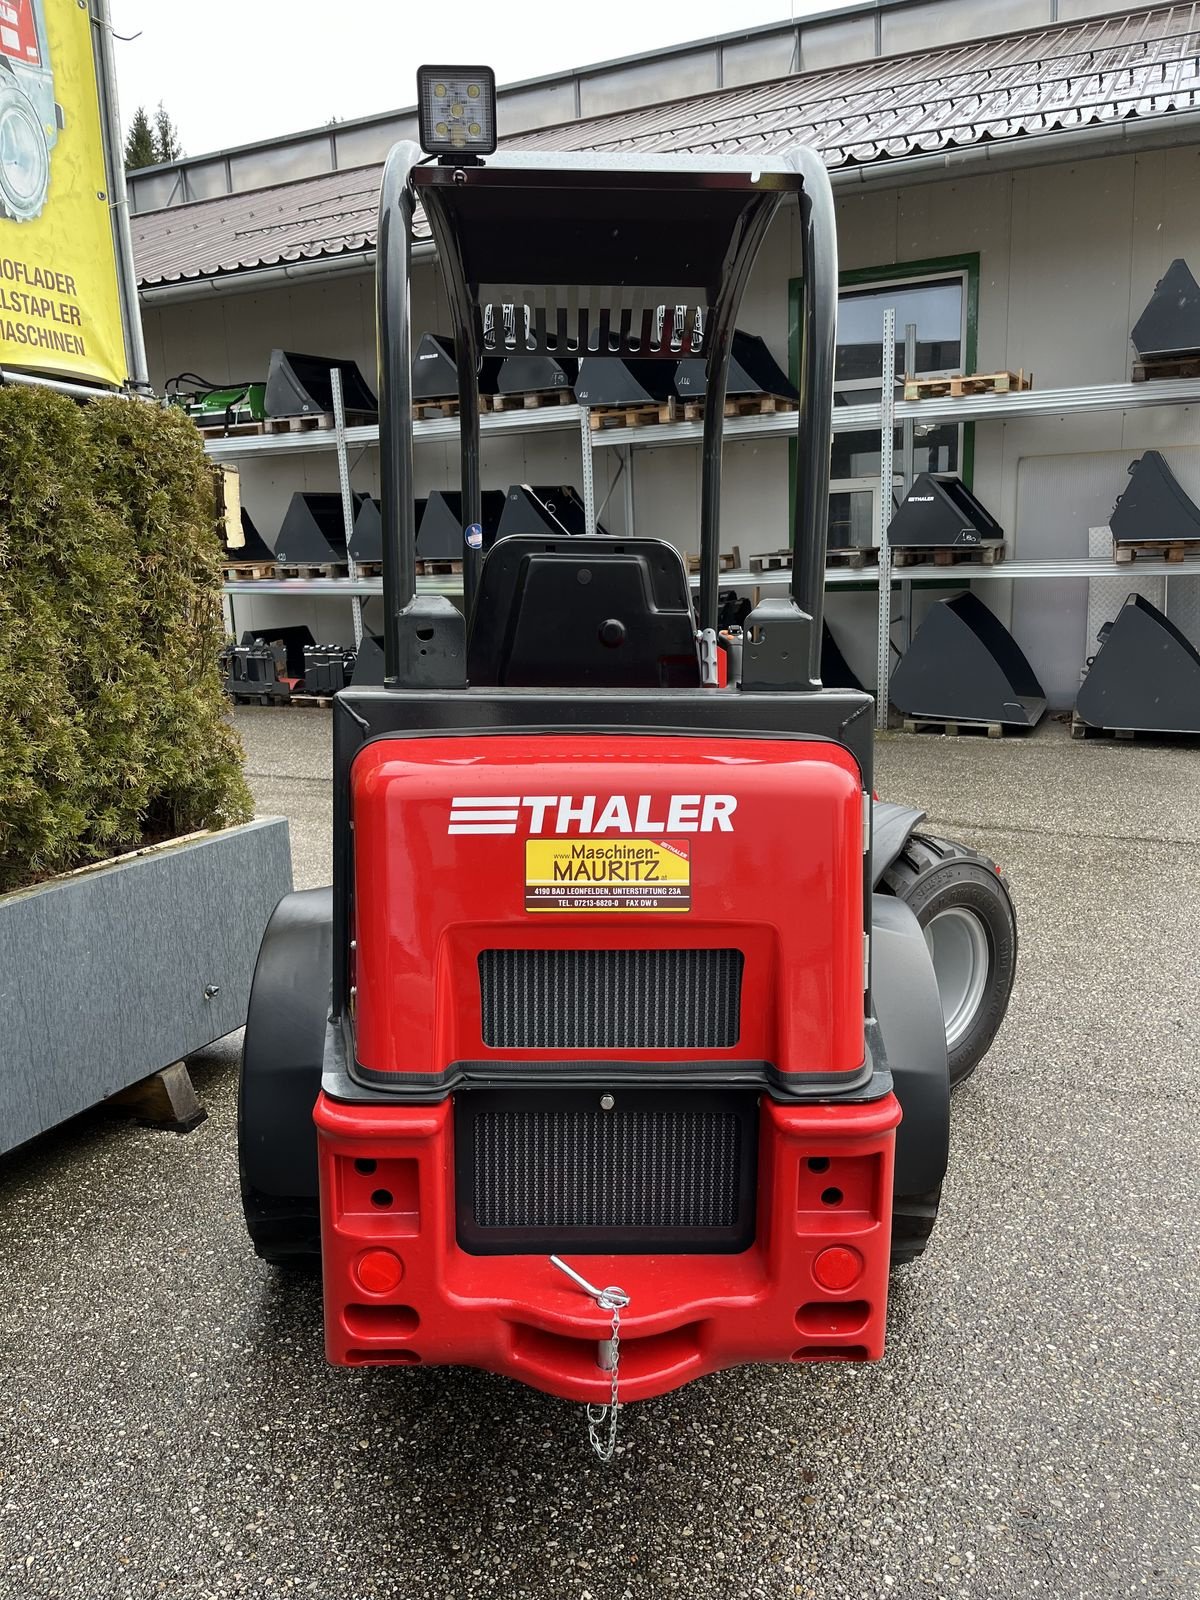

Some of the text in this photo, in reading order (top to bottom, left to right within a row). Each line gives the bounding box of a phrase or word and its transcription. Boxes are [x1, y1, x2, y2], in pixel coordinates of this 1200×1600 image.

[0, 288, 81, 326] LSTAPLER
[522, 794, 738, 834] THALER
[553, 860, 660, 882] MAURITZ
[566, 888, 611, 896] LEONFELDEN,
